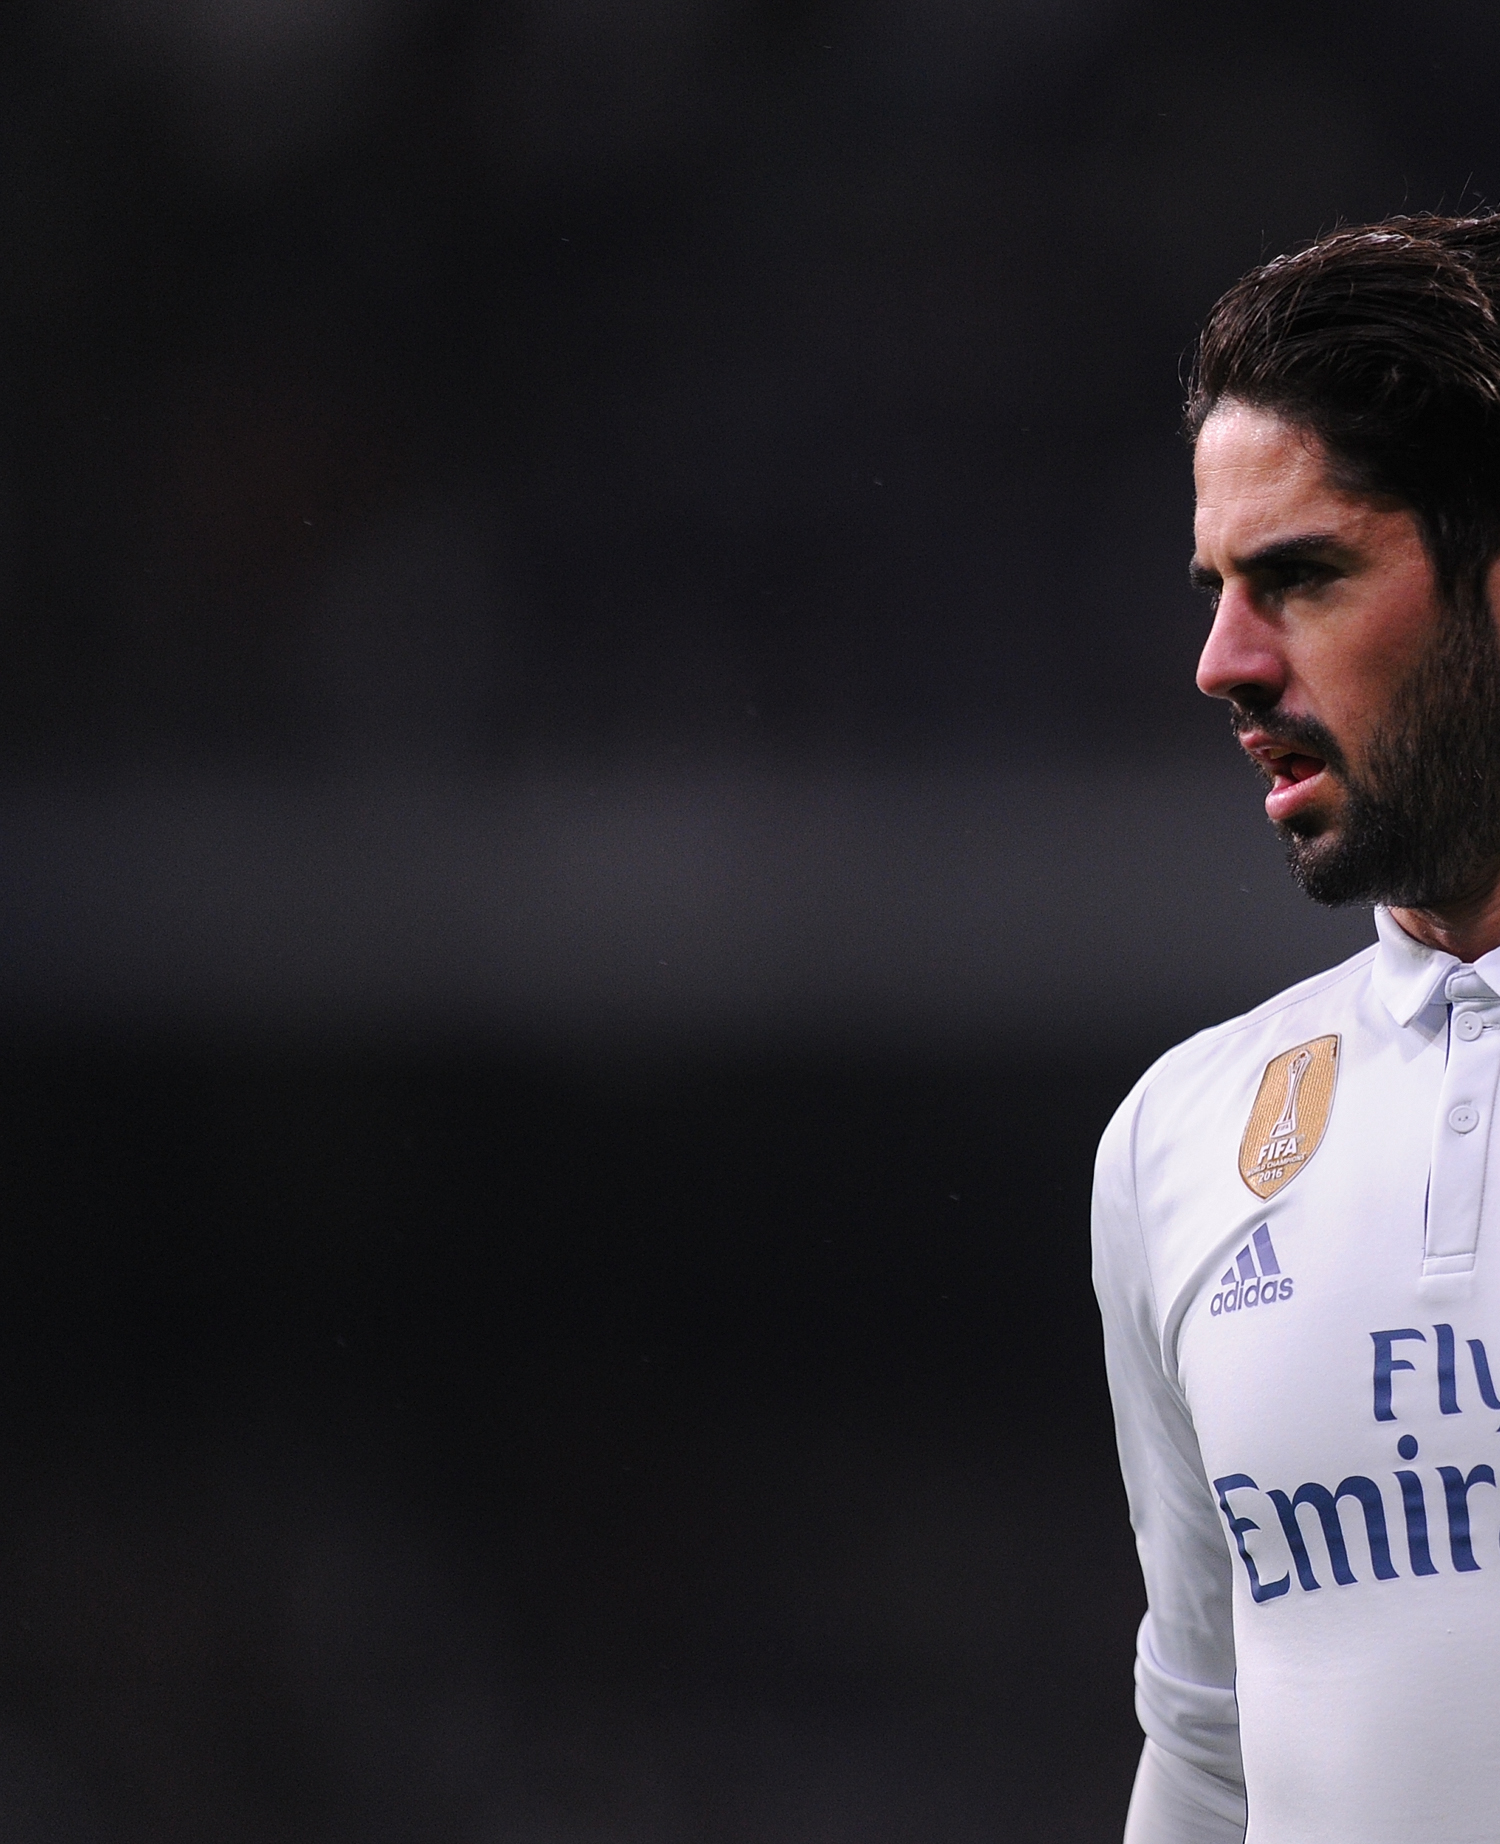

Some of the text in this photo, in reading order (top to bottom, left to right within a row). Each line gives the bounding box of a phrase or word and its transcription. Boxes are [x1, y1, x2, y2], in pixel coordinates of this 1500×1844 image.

[1258, 1137, 1297, 1165] FIFA
[1259, 1168, 1284, 1183] 2016
[1210, 1277, 1294, 1316] adidas
